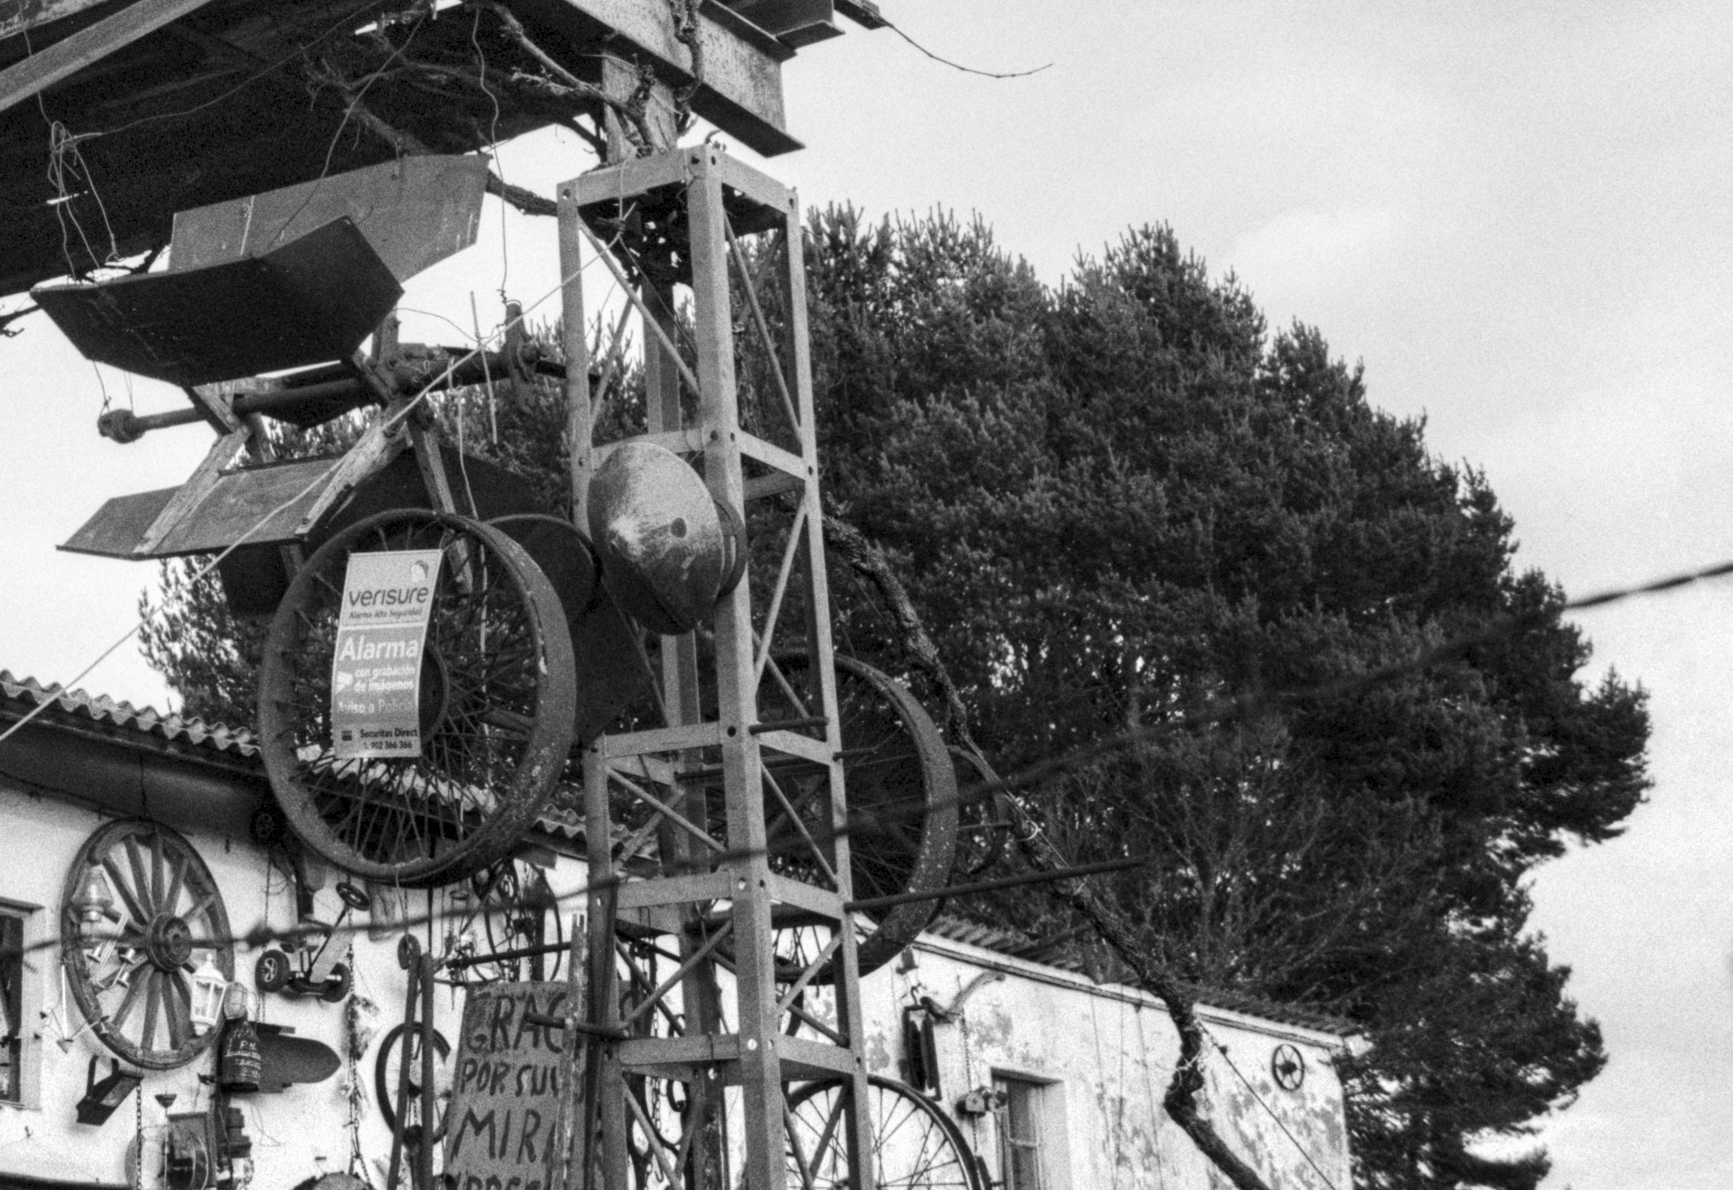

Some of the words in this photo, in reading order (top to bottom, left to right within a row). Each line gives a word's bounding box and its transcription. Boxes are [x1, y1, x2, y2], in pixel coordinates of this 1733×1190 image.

[348, 586, 429, 607] verisure
[339, 635, 419, 661] Alarma
[354, 668, 371, 678] con
[354, 680, 367, 692] de
[368, 702, 375, 714] a
[360, 728, 393, 739] Securitas
[394, 727, 419, 738] Direct
[460, 1058, 510, 1096] POR
